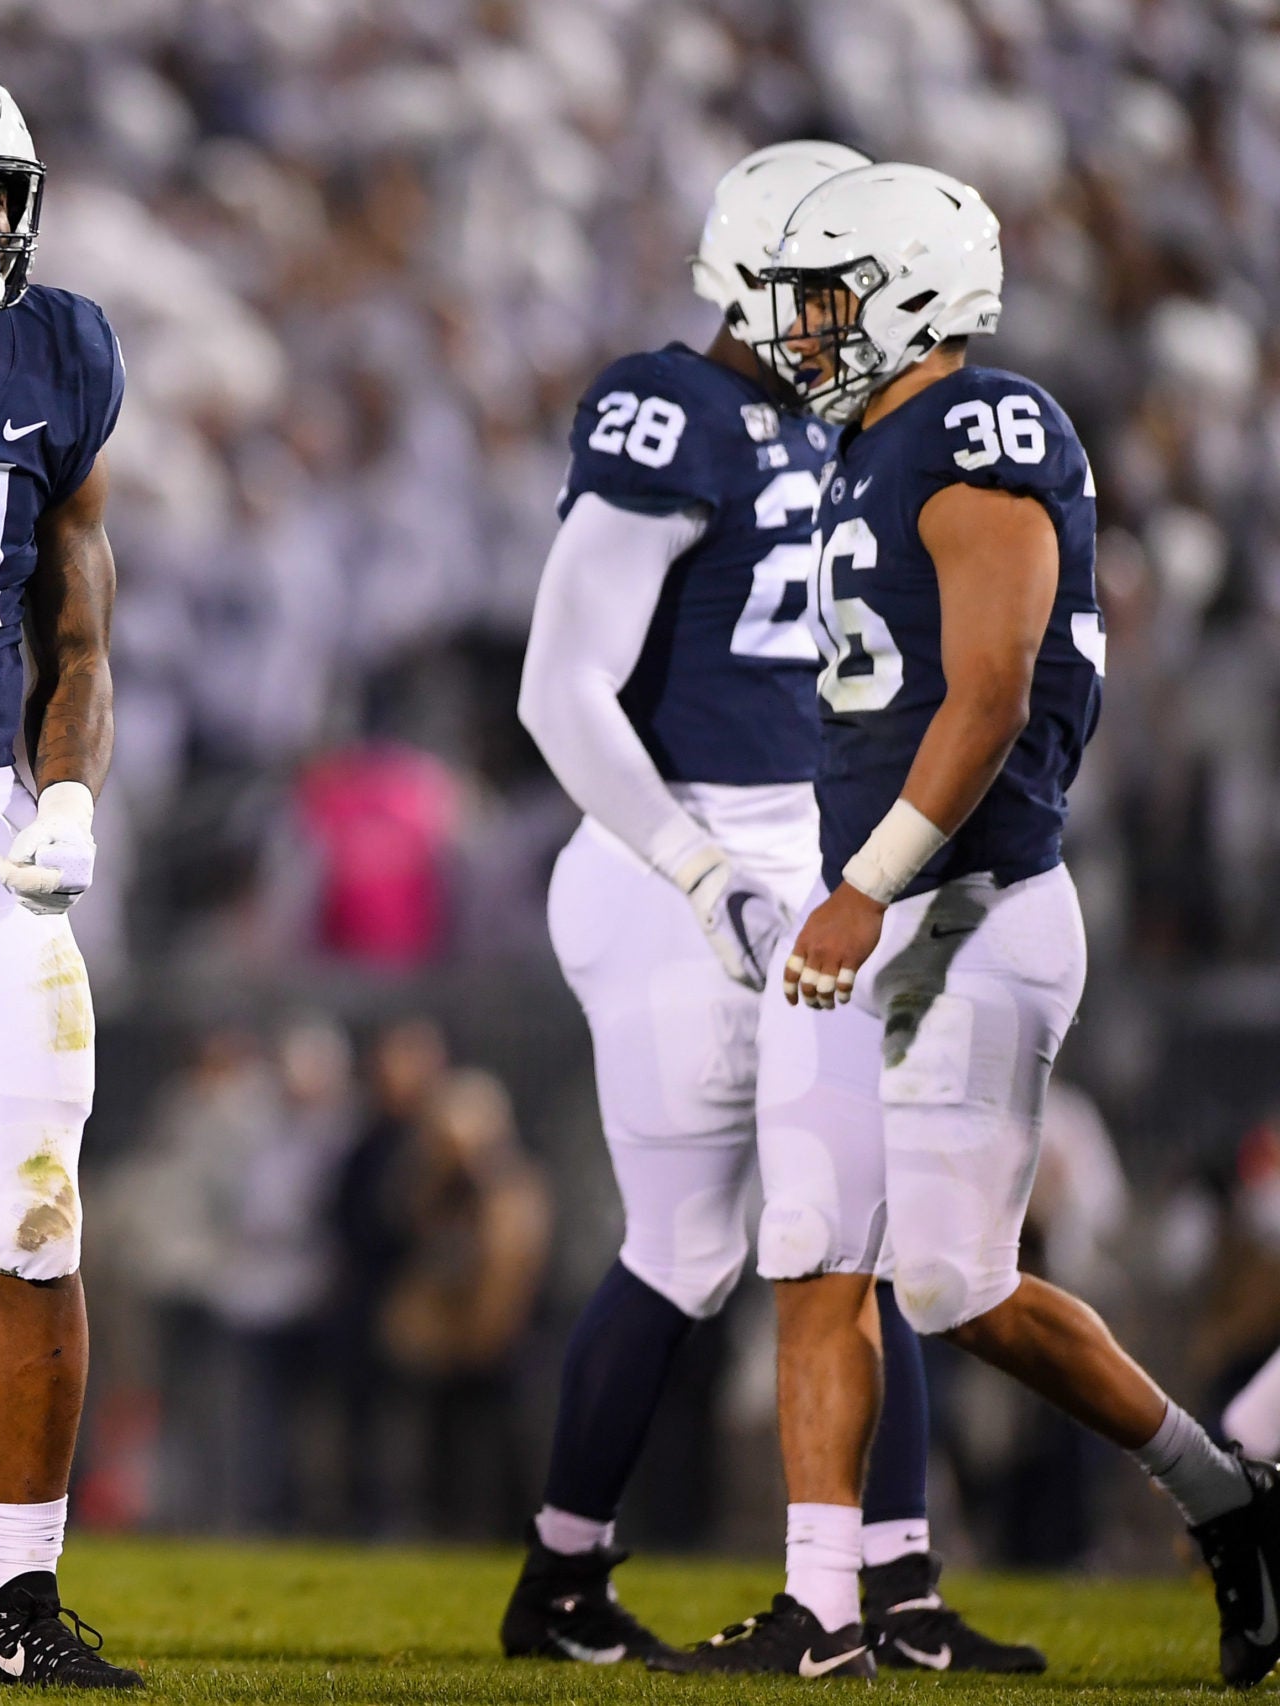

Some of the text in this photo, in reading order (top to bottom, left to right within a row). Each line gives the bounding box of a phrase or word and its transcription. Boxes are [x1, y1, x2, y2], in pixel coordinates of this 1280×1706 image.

[588, 391, 687, 469] 28
[943, 394, 1046, 471] 36
[730, 470, 821, 661] 2
[816, 516, 905, 713] 6
